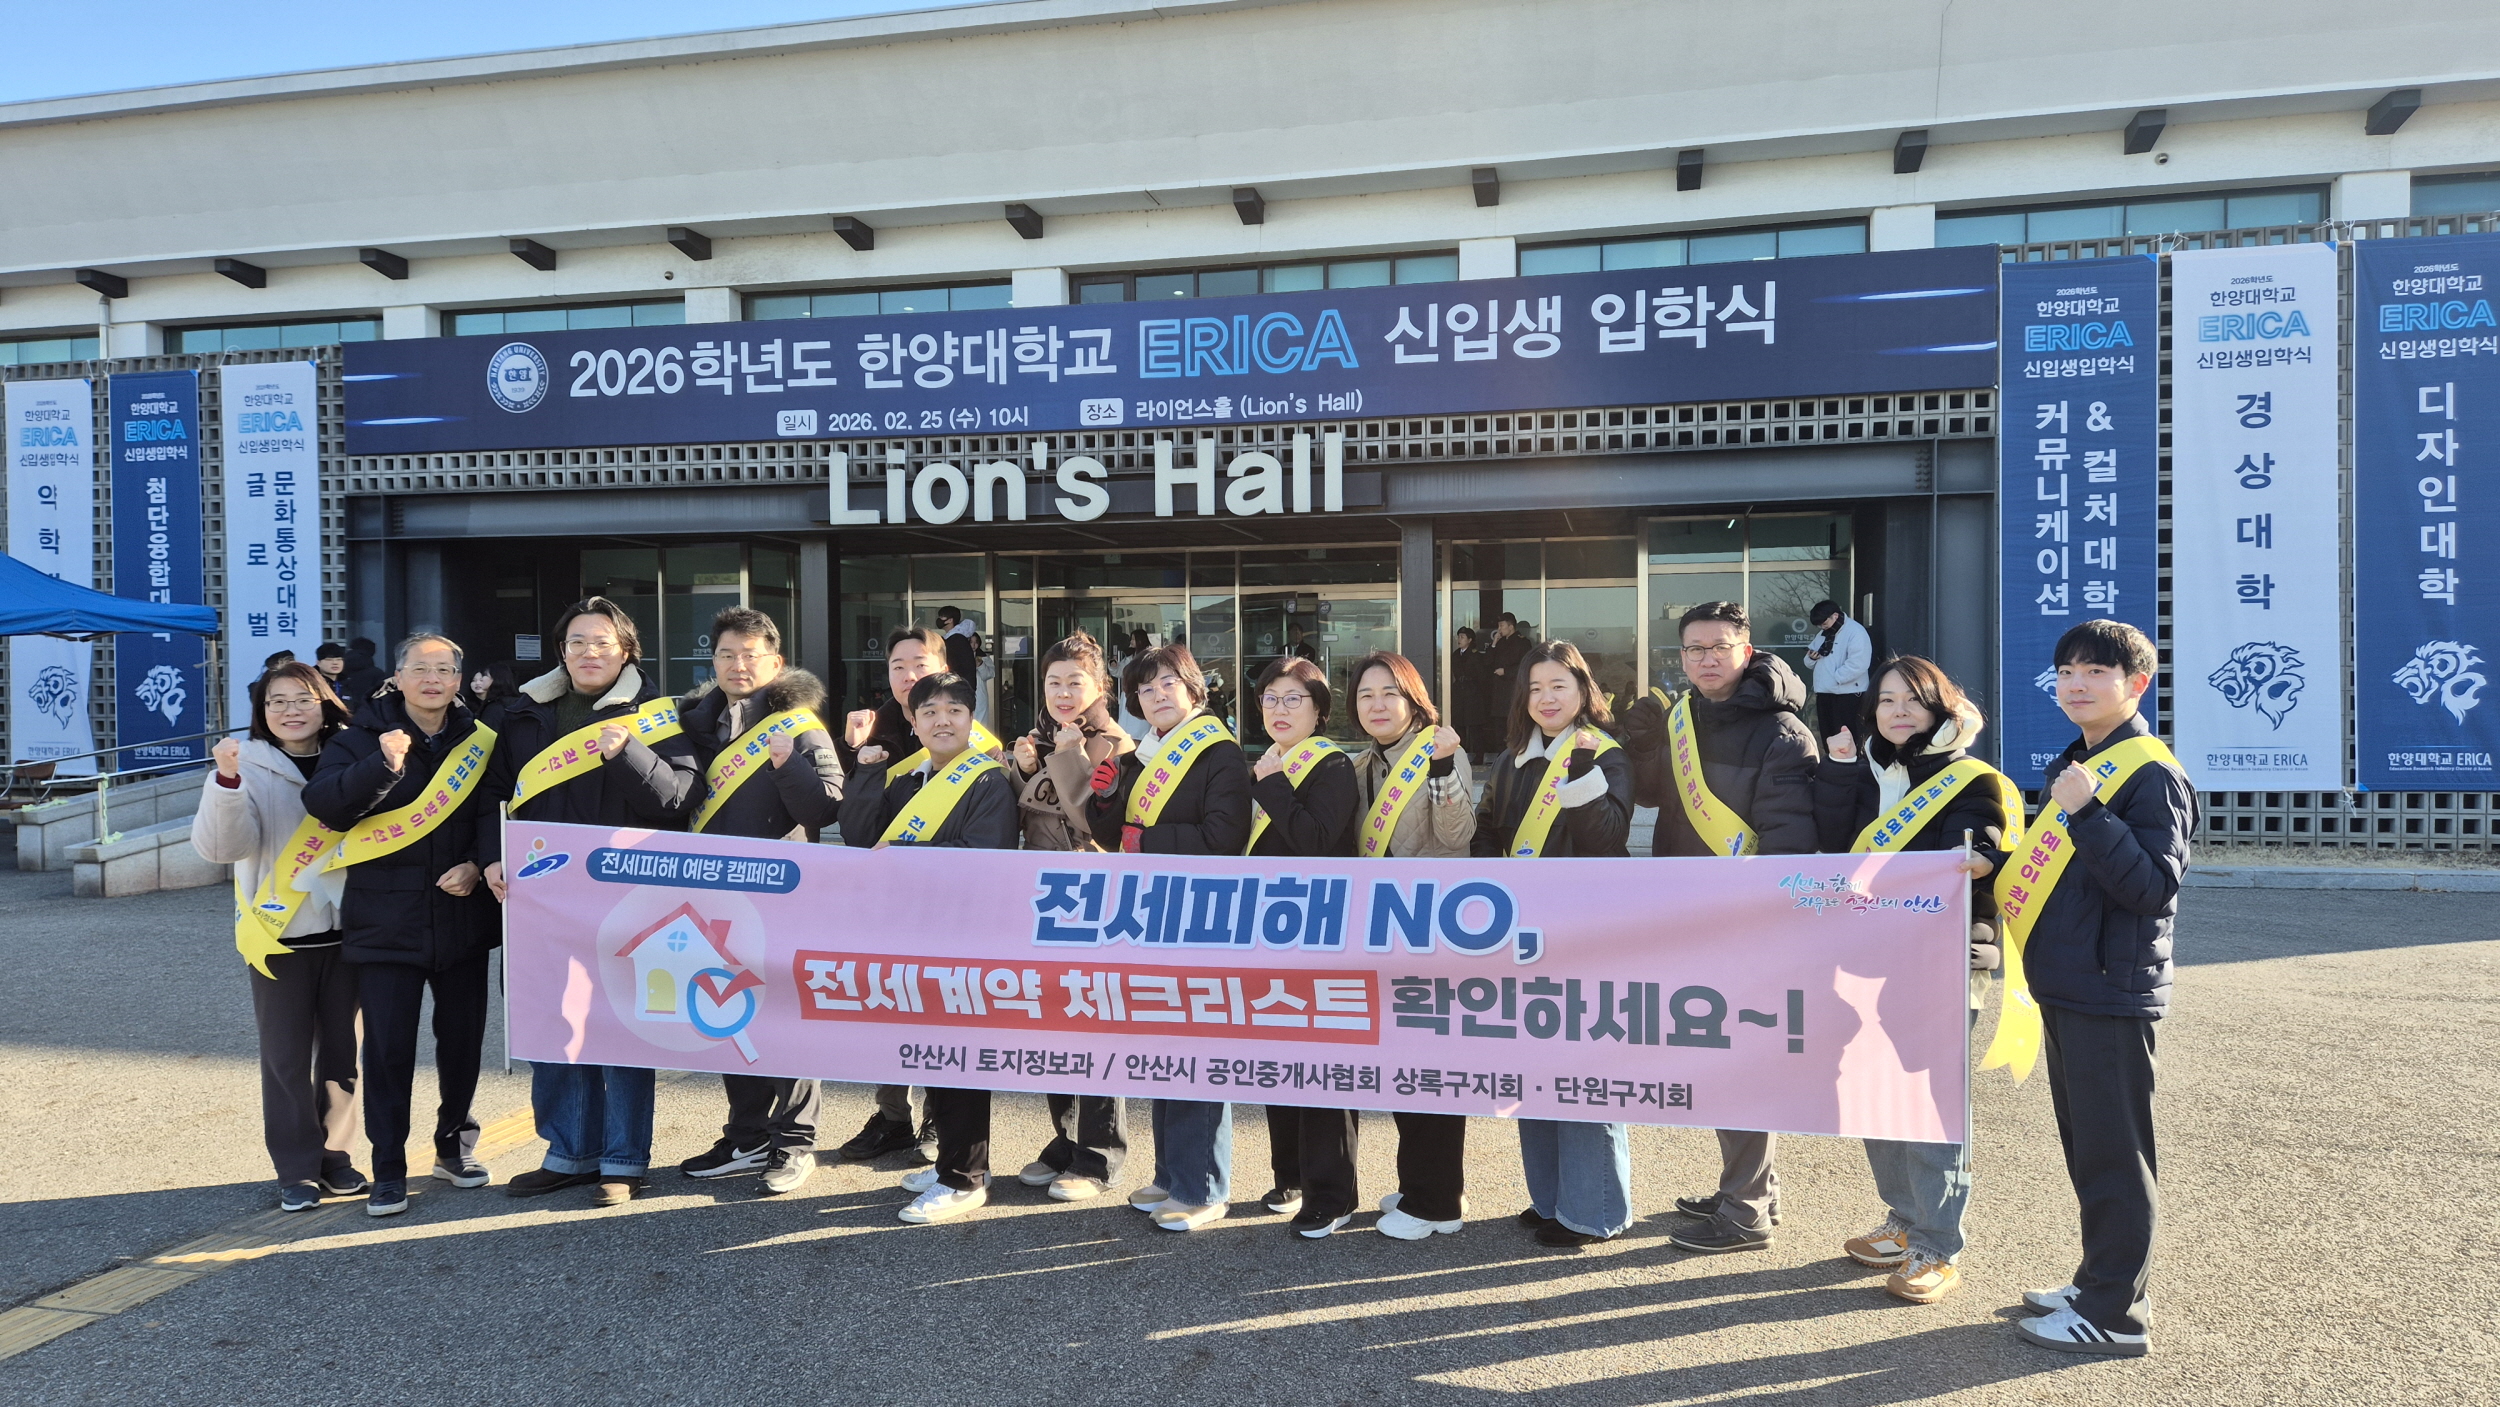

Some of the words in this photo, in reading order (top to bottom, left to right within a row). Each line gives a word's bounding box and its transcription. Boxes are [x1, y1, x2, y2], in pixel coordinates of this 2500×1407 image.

[2230, 275, 2274, 285] 2026학년도
[2413, 263, 2460, 274] 2026학년도
[2055, 286, 2098, 296] 2026학년도
[2209, 286, 2296, 307] 한양대학교
[2392, 274, 2483, 296] 한양대학교
[2036, 297, 2120, 318] 한양대학교
[2379, 299, 2497, 333] ERICA
[569, 337, 839, 400] 2026학년도
[857, 323, 1118, 390] 한양대학교
[1138, 308, 1360, 379] ERICA
[1383, 294, 1563, 365] 신입생
[1590, 280, 1778, 354] 입학식
[2024, 320, 2134, 352] ERICA
[2198, 310, 2311, 342] ERICA
[2196, 345, 2311, 370] 신입생입학식
[2378, 335, 2498, 360] 신입생입학식
[2023, 354, 2135, 378] 신입생입학식
[25, 409, 71, 422] 한양대학교
[130, 401, 179, 416] 한양대학교
[243, 393, 294, 407] 한양대학교
[782, 412, 813, 433] 일시
[828, 412, 878, 433] 2026.
[884, 411, 914, 431] 02.
[920, 410, 943, 430] 25
[949, 408, 982, 433] (수)
[988, 406, 1029, 428] 10시
[1085, 401, 1119, 423] 장소
[1136, 395, 1234, 419] 라이언스홀
[1239, 391, 1308, 419] (Lion's
[1318, 388, 1364, 413] Hall)
[20, 426, 79, 447] ERICA
[124, 419, 187, 442] ERICA
[238, 411, 304, 433] ERICA
[124, 445, 188, 462] 신입생입학식
[238, 438, 305, 454] 신입생입학식
[829, 441, 1109, 527] Lion's
[1153, 432, 1344, 517] Hall
[2415, 381, 2460, 606] 디자인대학
[2034, 400, 2071, 616] 커뮤니케이션
[2233, 390, 2276, 610] 경상대학
[146, 477, 172, 643] 첨단융합대
[246, 472, 270, 638] 글로벌
[273, 471, 299, 638] 문화통상대학
[636, 706, 679, 734] 세피해
[170, 746, 191, 757] ERICA
[537, 747, 580, 775] 최선!
[1166, 723, 1220, 768] 전세피해
[1676, 733, 1693, 778] 예방이
[2206, 753, 2269, 767] 한양대학교
[2273, 753, 2308, 766] ERICA
[2387, 752, 2453, 767] 한양대학교
[2456, 752, 2492, 766] ERICA
[446, 743, 485, 793] 전세피해
[711, 753, 747, 791] 안산시
[1399, 740, 1436, 784] 세피해
[1138, 766, 1171, 812] 예방이
[409, 789, 450, 828] 예방이
[1372, 785, 1404, 833] 예방이
[360, 823, 406, 844] 최선!
[600, 851, 679, 880] 전세피해
[681, 855, 723, 882] 예방
[726, 858, 786, 887] 캠페인
[2019, 829, 2062, 884] 예방이
[1031, 865, 1347, 950] 전세피해
[1364, 874, 1545, 965] NO,
[1902, 895, 1948, 914] 안산
[804, 956, 1044, 1021] 전세계약
[1058, 966, 1373, 1033] 체크리스트
[1390, 974, 1805, 1054] 확인하세요~!
[899, 1042, 967, 1073] 안산시
[975, 1044, 1095, 1081] 토지정보과
[1125, 1051, 1198, 1085] 안산시
[1206, 1056, 1382, 1096] 공인중개사협회
[1391, 1066, 1525, 1103] 상록구지회
[1554, 1076, 1694, 1112] 단원구지회
